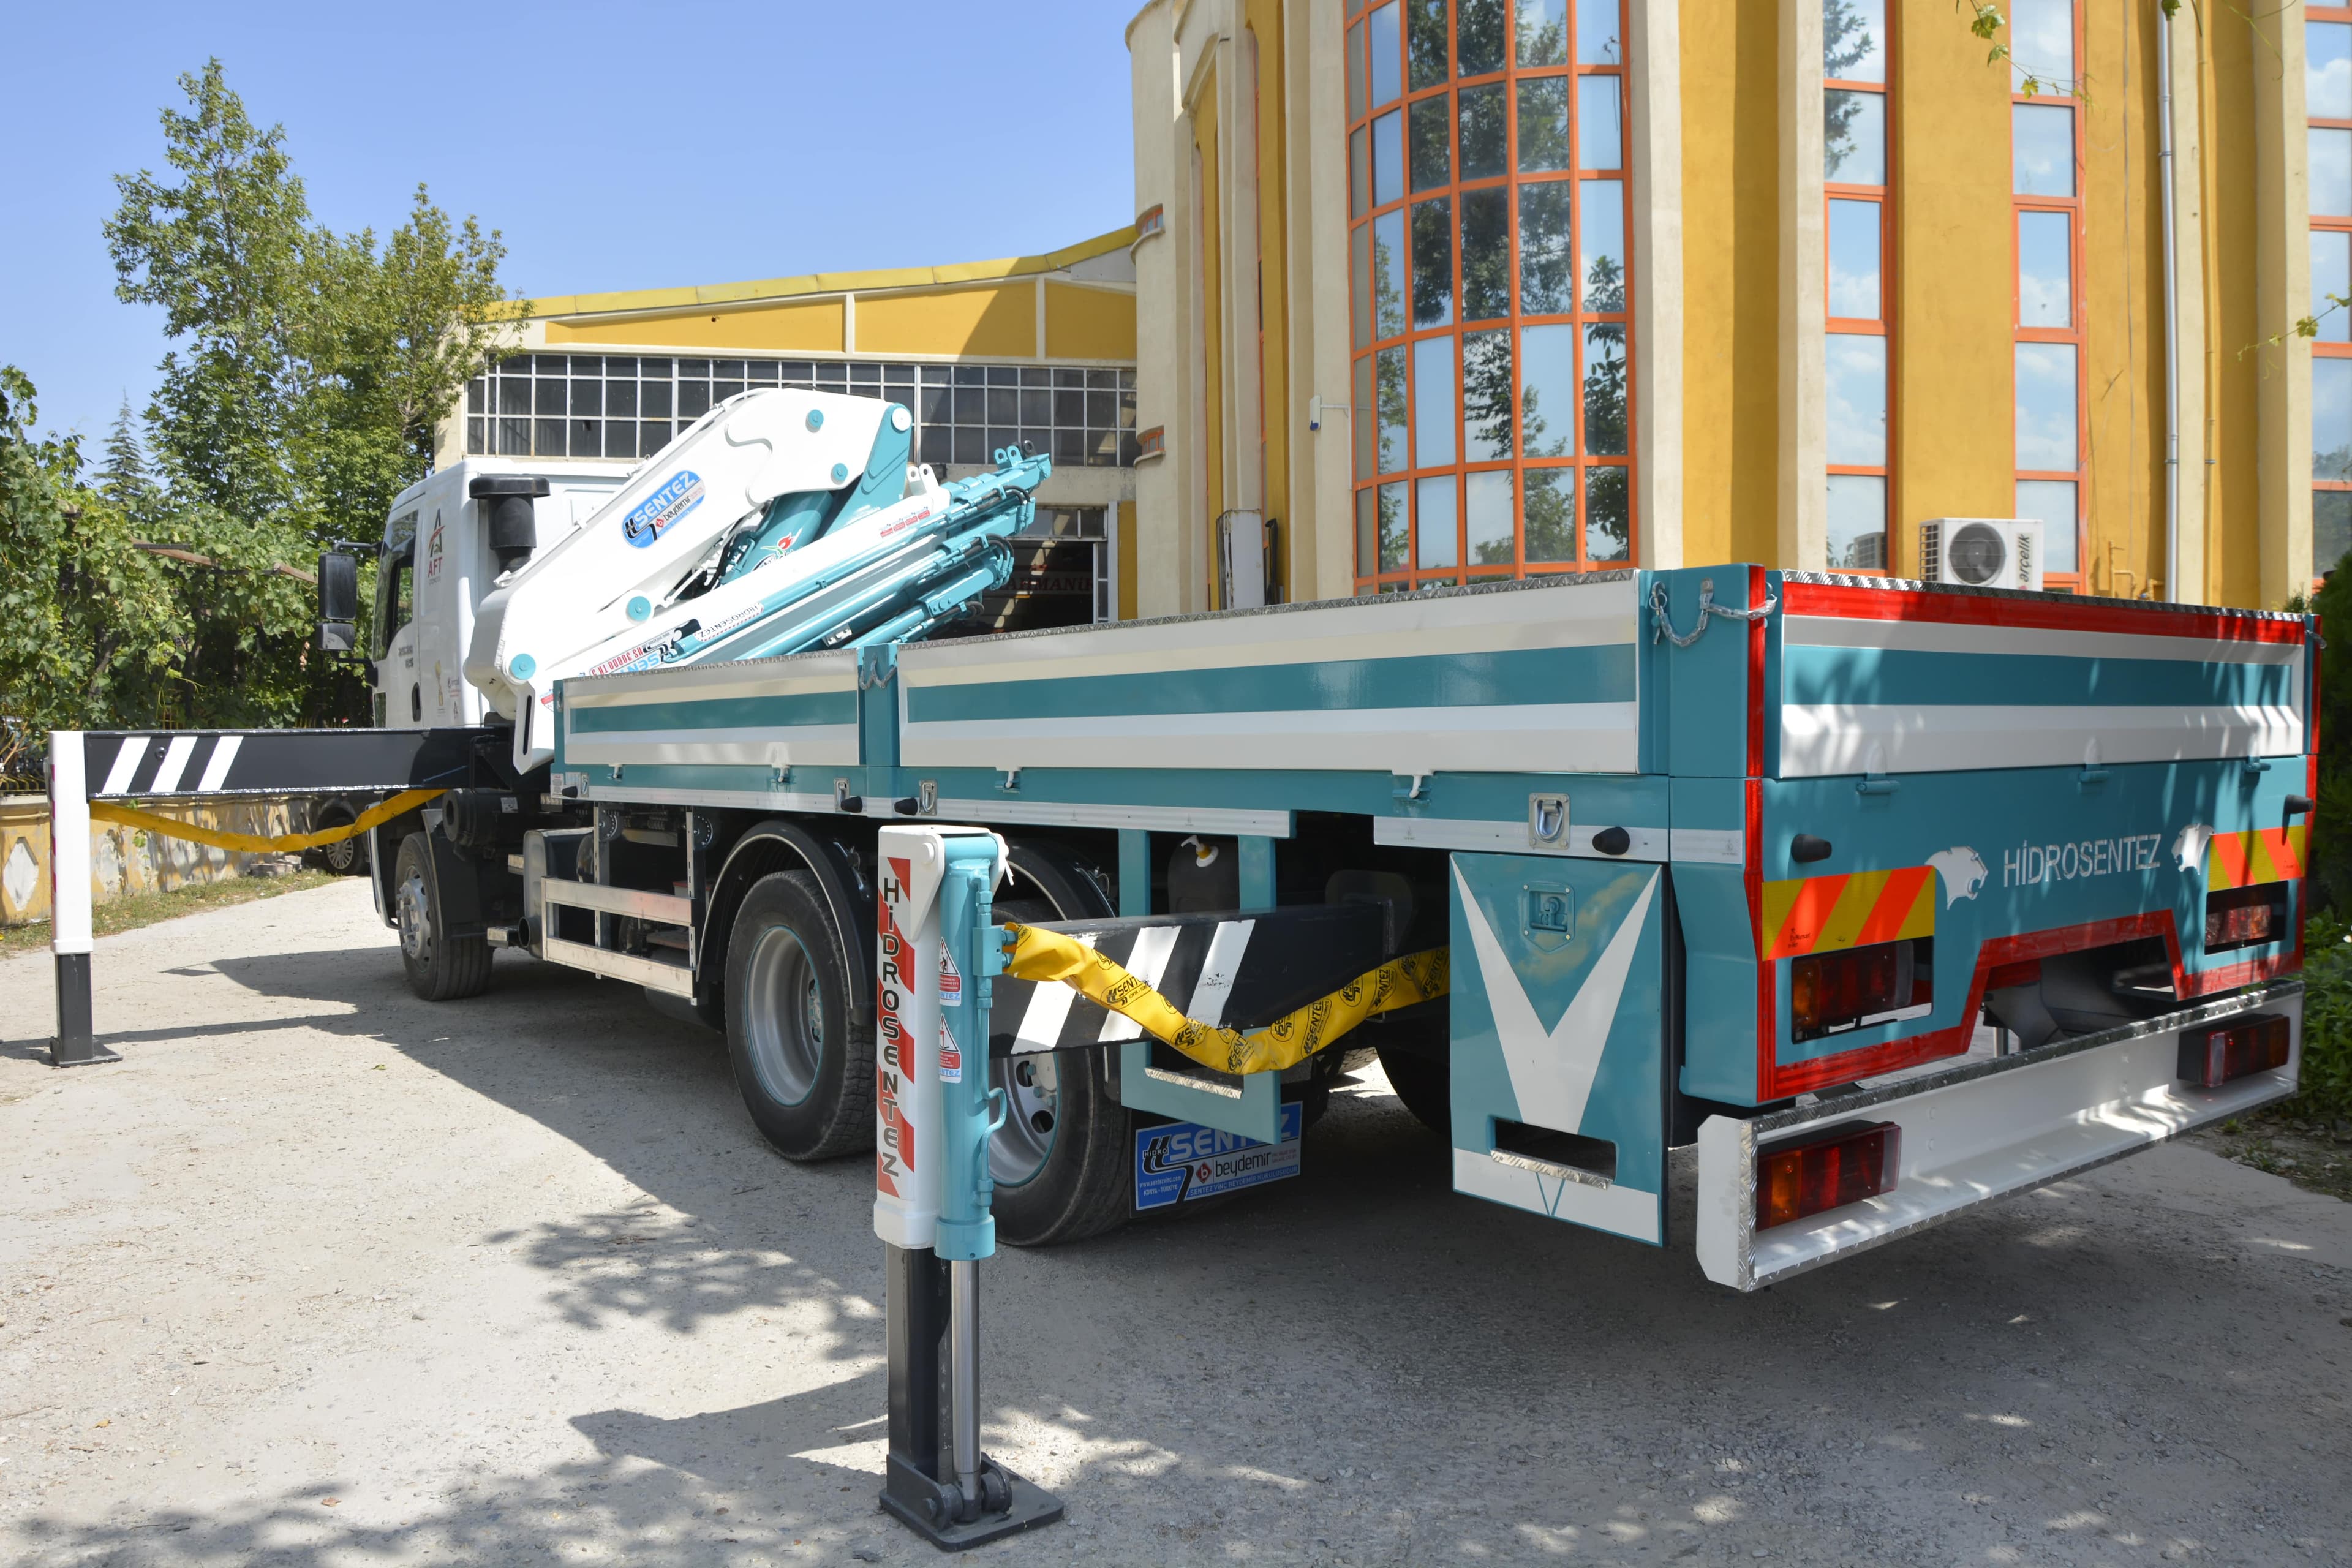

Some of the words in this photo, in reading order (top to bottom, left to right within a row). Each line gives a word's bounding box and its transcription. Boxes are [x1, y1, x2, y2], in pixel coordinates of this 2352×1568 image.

[633, 472, 695, 529] SENTEZ
[663, 495, 692, 521] beydemir
[428, 556, 443, 578] AFT
[2019, 533, 2032, 582] arçelik
[608, 652, 633, 670] 30000
[633, 646, 644, 658] HS
[1215, 1152, 1272, 1178] beydemir
[1144, 1188, 1158, 1196] KONYA
[1189, 1185, 1213, 1196] SENTEZ
[1228, 1176, 1256, 1187] BEYDEMİR
